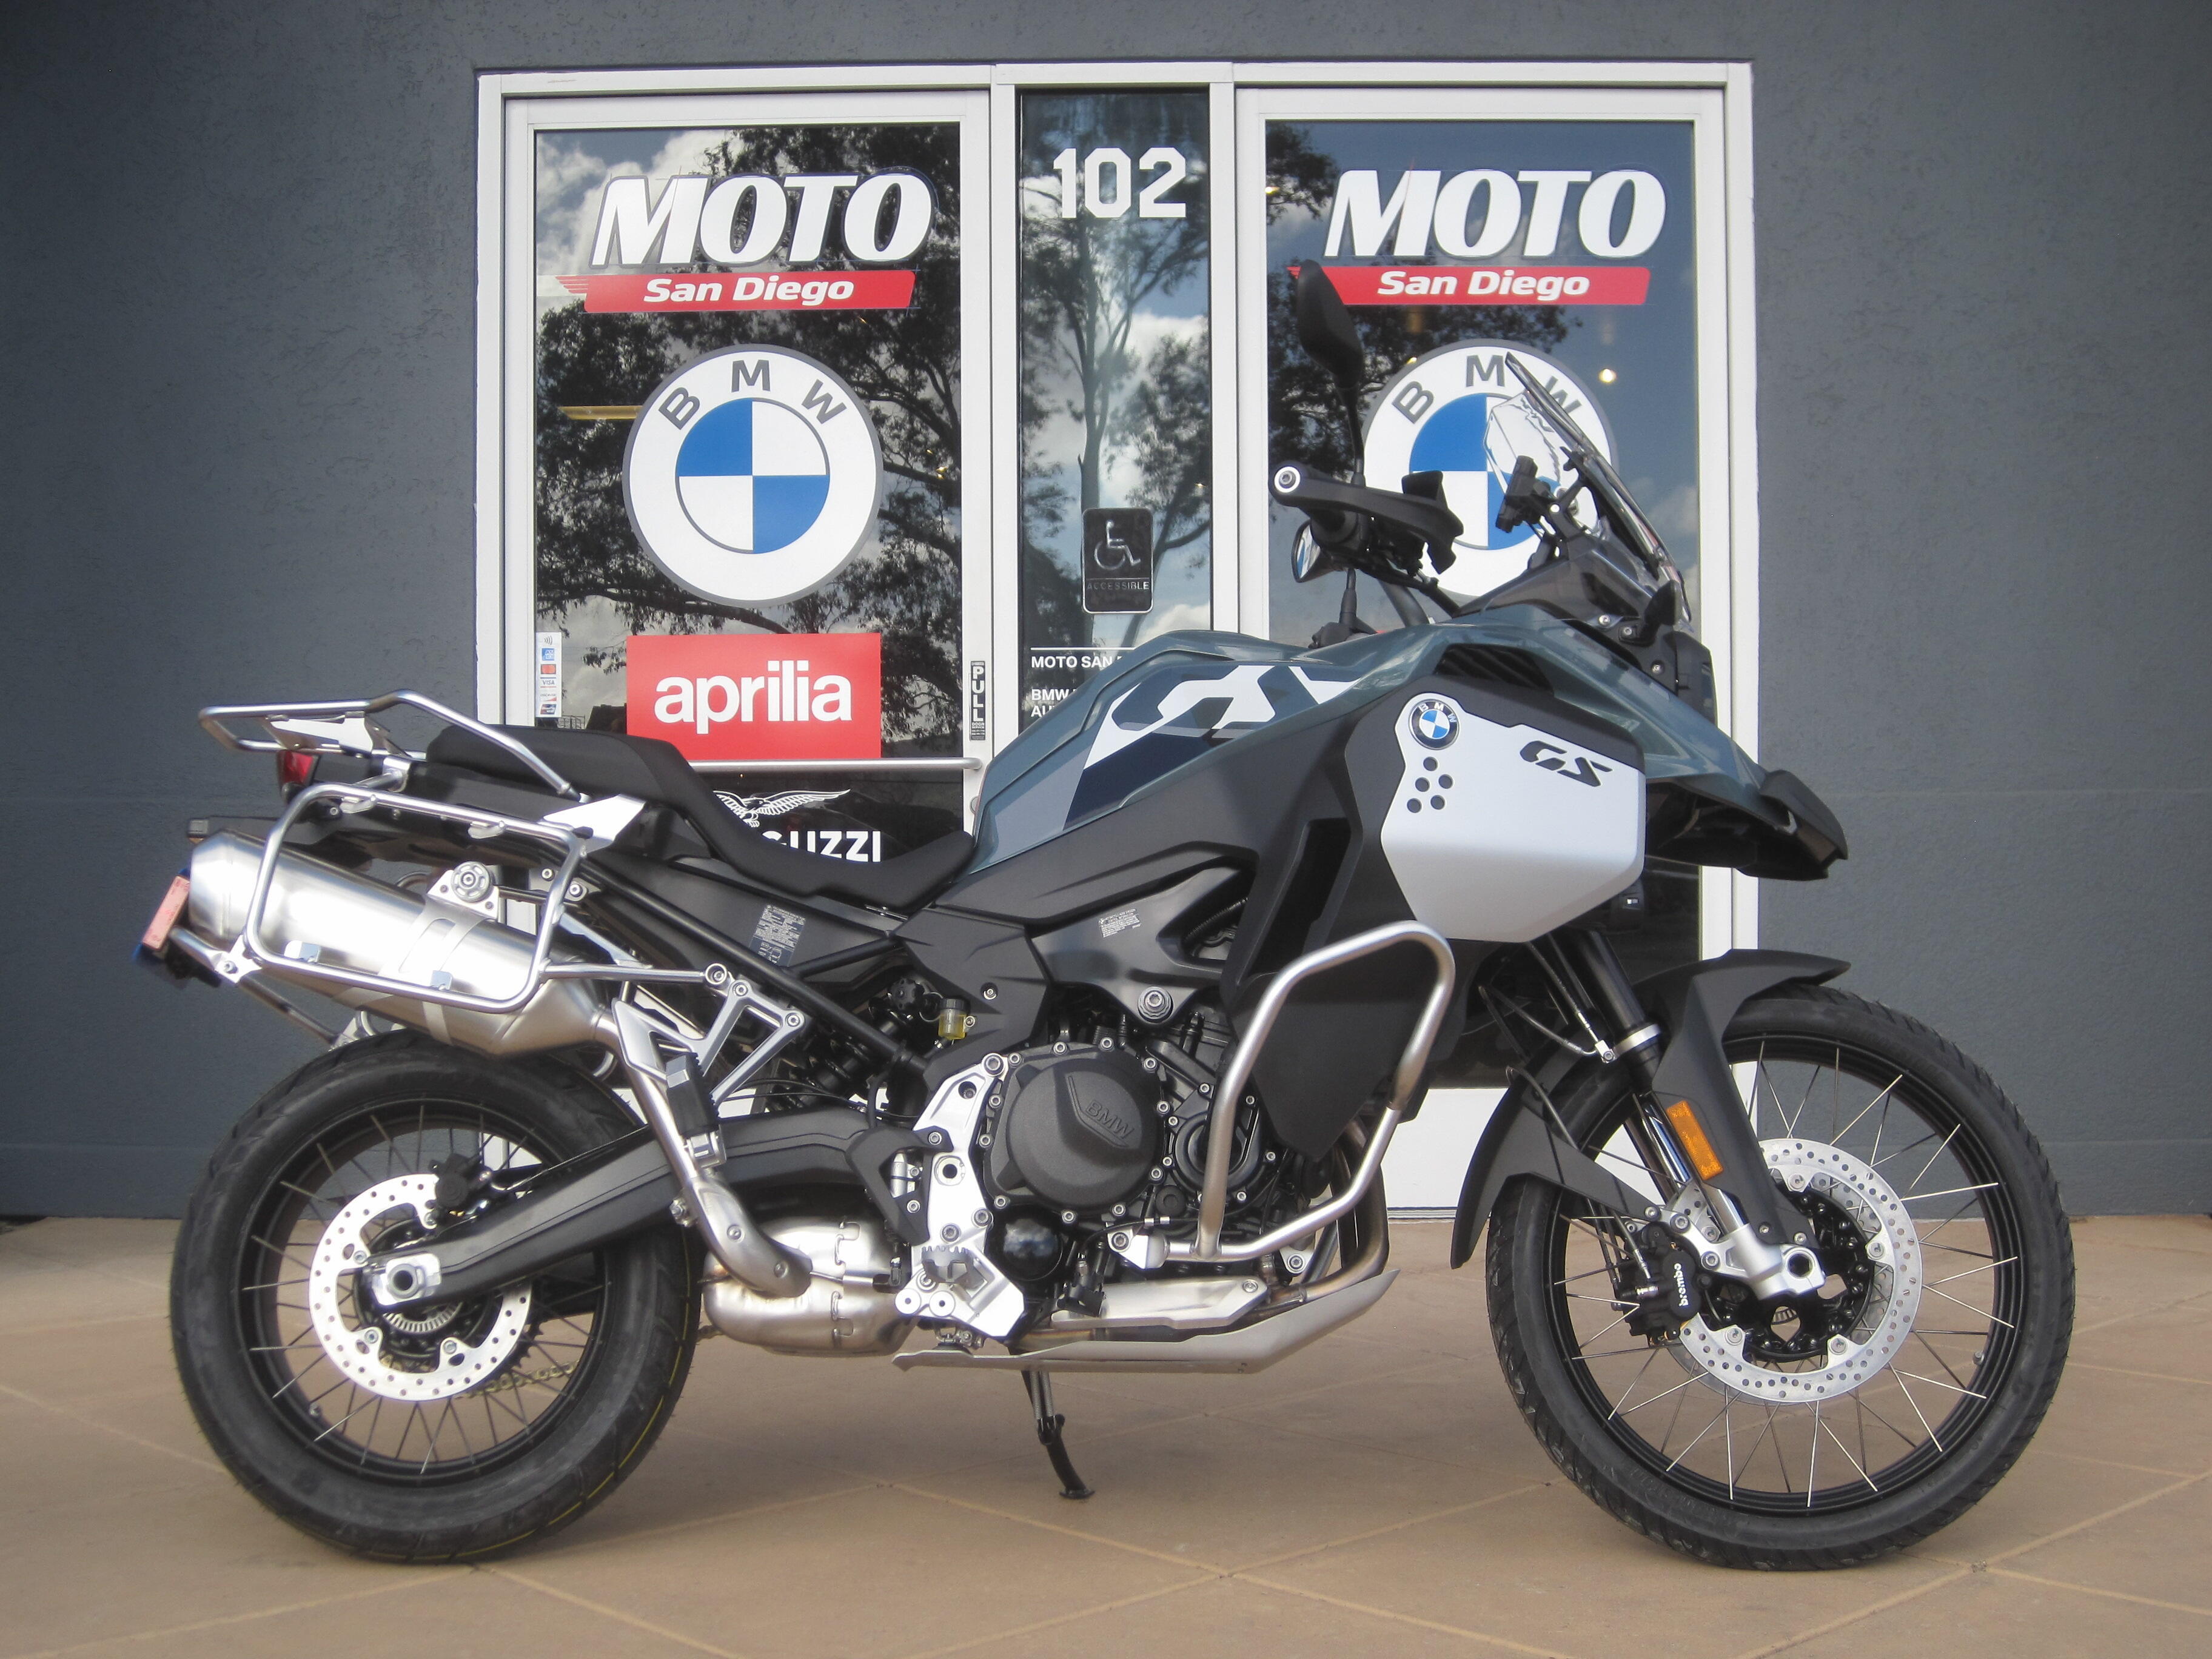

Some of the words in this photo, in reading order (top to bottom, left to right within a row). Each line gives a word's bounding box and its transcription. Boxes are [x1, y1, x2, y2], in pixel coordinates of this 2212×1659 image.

[1053, 147, 1186, 218] 102
[590, 173, 933, 266] MOTO
[1324, 169, 1667, 258] MOTO
[644, 278, 722, 303] San
[732, 275, 855, 306] Diego
[1378, 271, 1457, 295] San
[1467, 269, 1590, 301] Diego
[659, 359, 847, 430] BMW
[1087, 581, 1150, 590] ACCESSIBLE
[1031, 655, 1078, 668] MOTO
[1081, 655, 1113, 668] SAN
[654, 660, 851, 734] aprilia
[971, 666, 985, 722] PULL
[1031, 689, 1069, 701] BMW
[1418, 702, 1457, 723] BMW
[1520, 740, 1613, 787] GS
[1086, 1100, 1134, 1139] BMW
[1674, 1262, 1689, 1307] brembo
